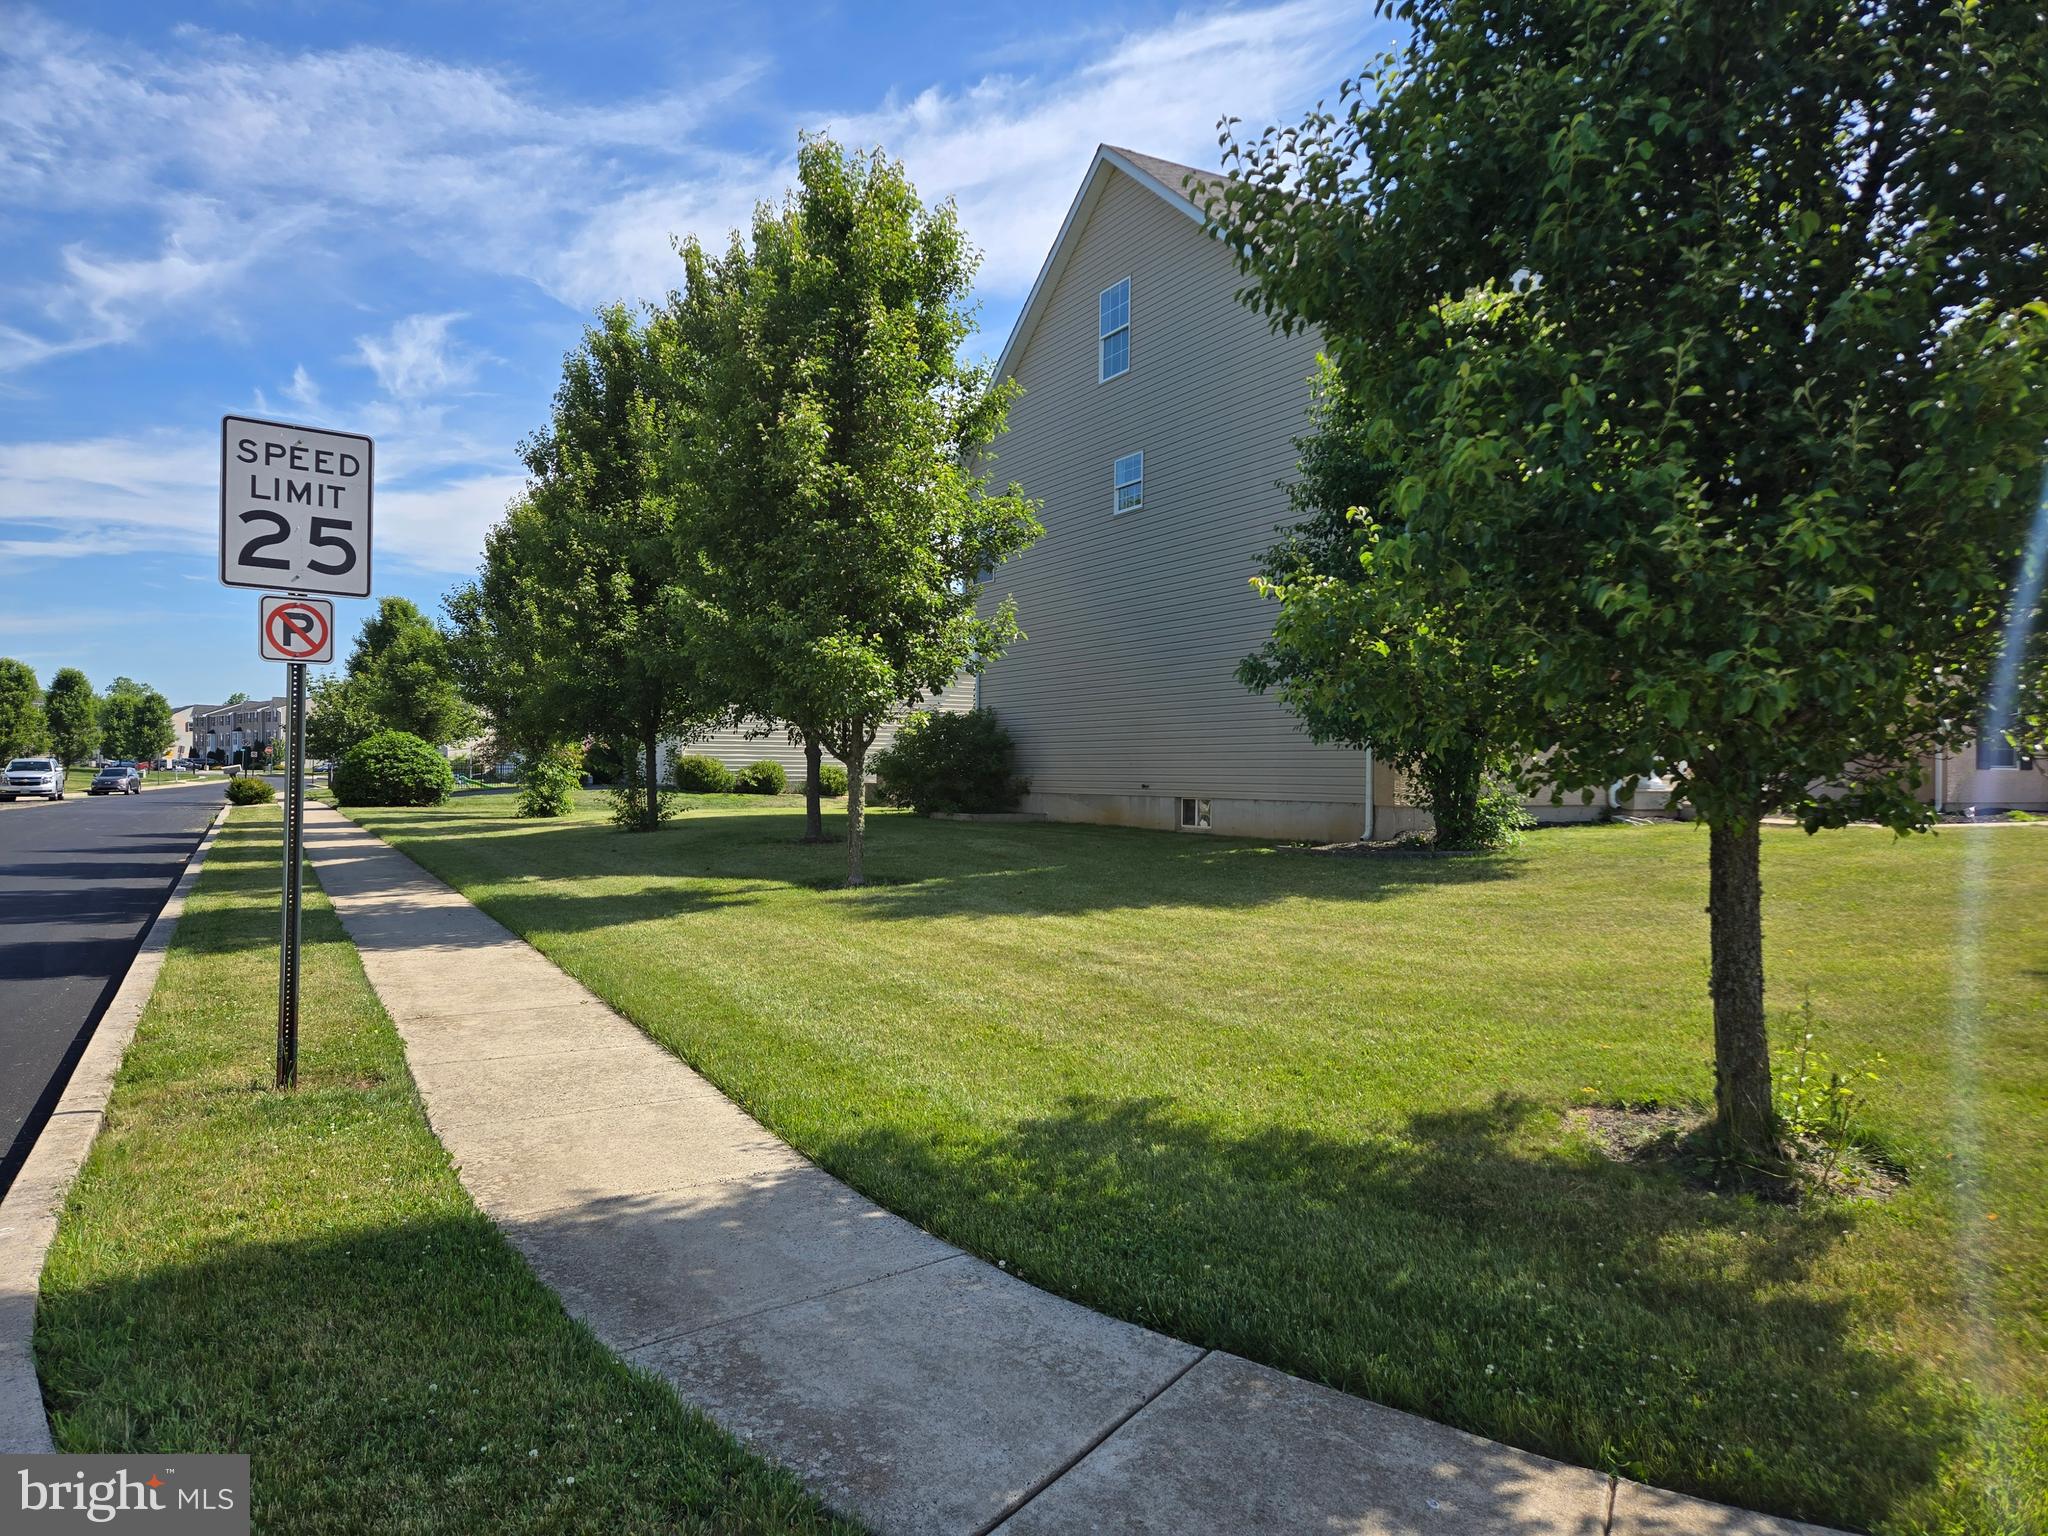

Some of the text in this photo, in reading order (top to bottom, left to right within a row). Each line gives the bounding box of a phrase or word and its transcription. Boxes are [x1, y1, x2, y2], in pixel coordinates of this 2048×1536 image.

[236, 438, 360, 477] SPEED
[250, 474, 346, 509] LIMIT
[237, 509, 357, 576] 25
[282, 611, 315, 647] P
